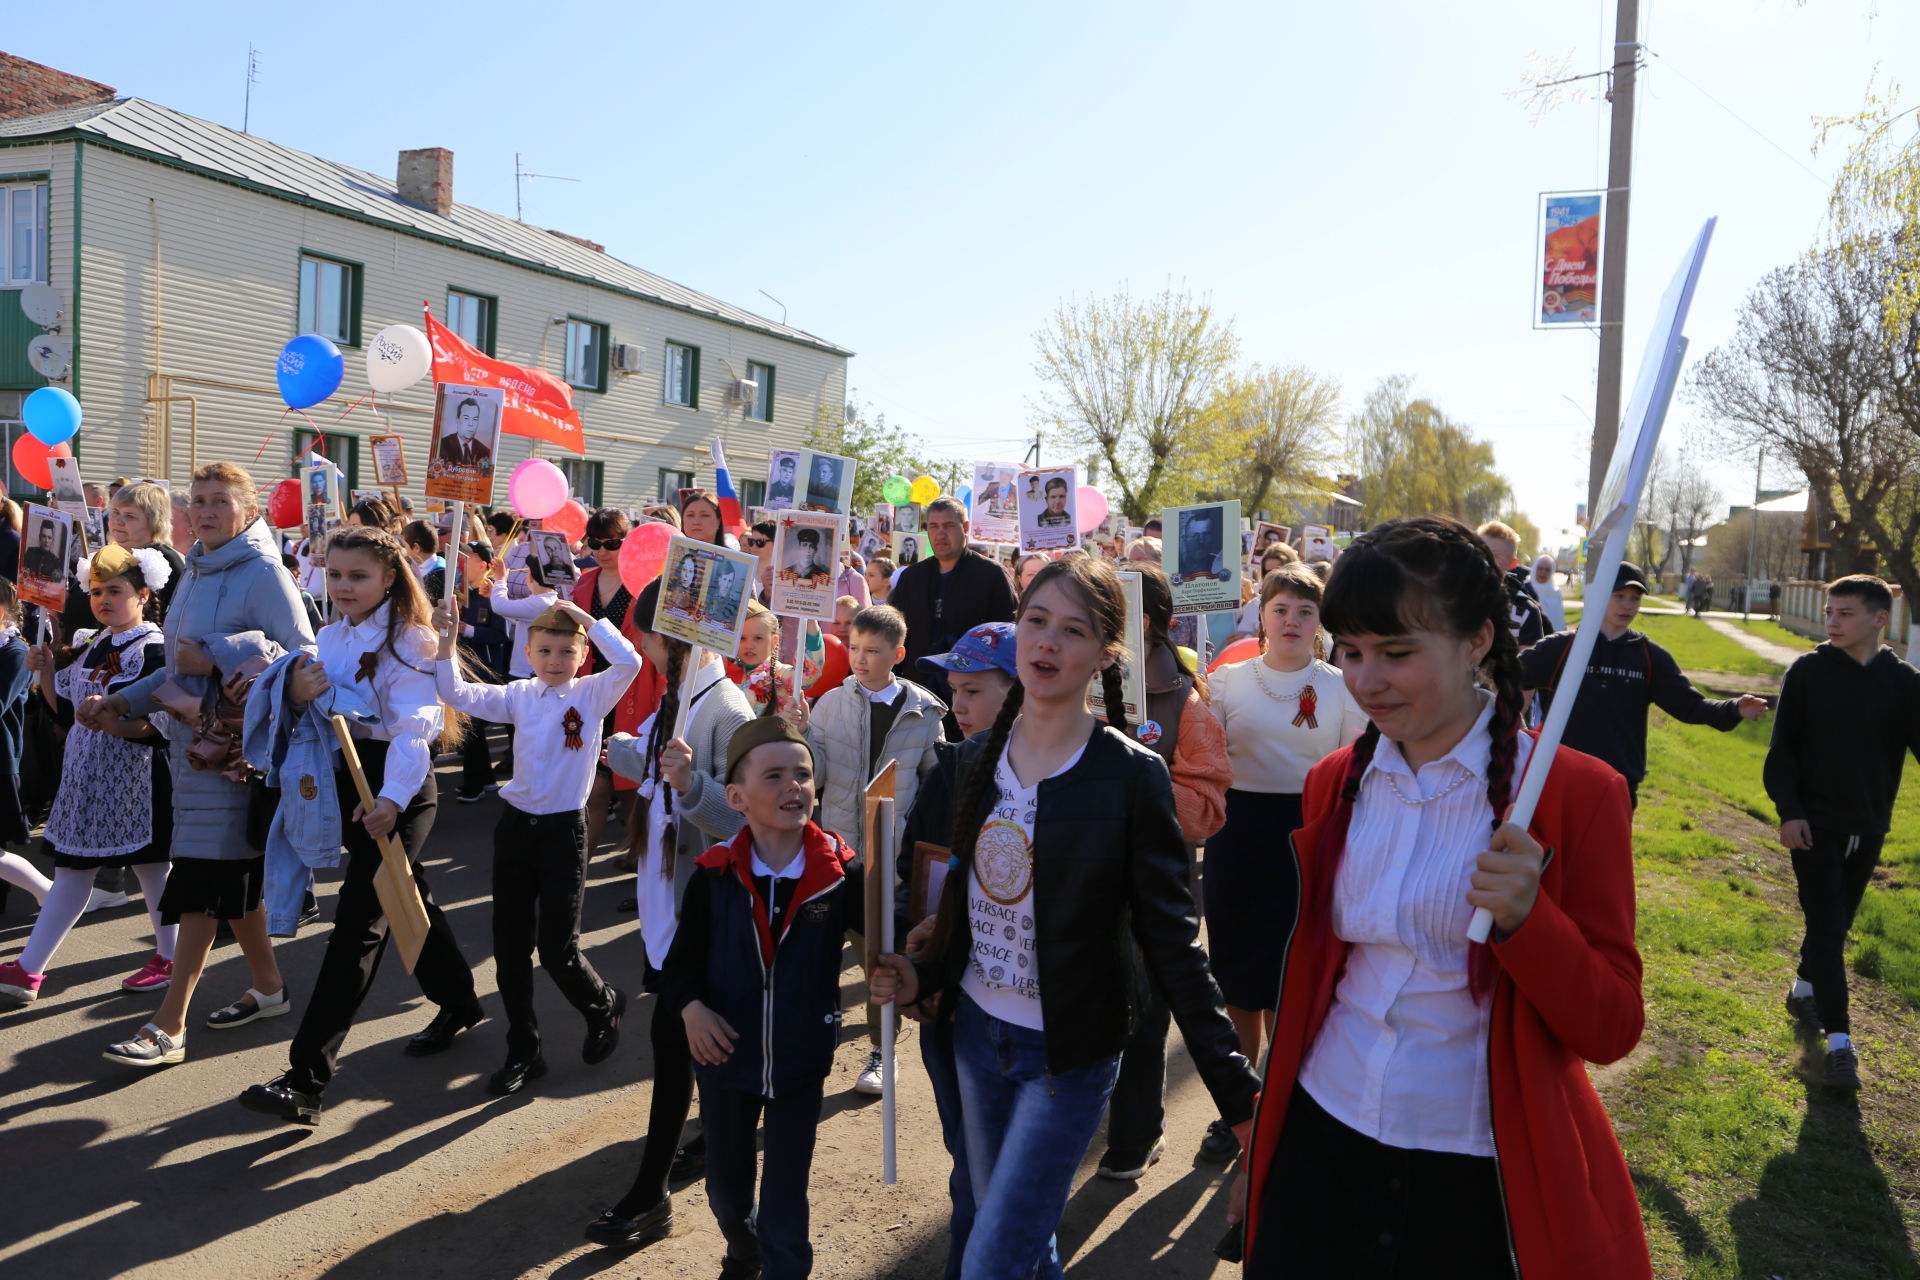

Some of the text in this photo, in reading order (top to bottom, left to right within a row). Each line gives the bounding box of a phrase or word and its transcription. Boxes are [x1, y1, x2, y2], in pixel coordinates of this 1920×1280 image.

[1550, 207, 1570, 217] 1941
[1544, 259, 1555, 272] С
[971, 897, 1017, 923] VERSACE
